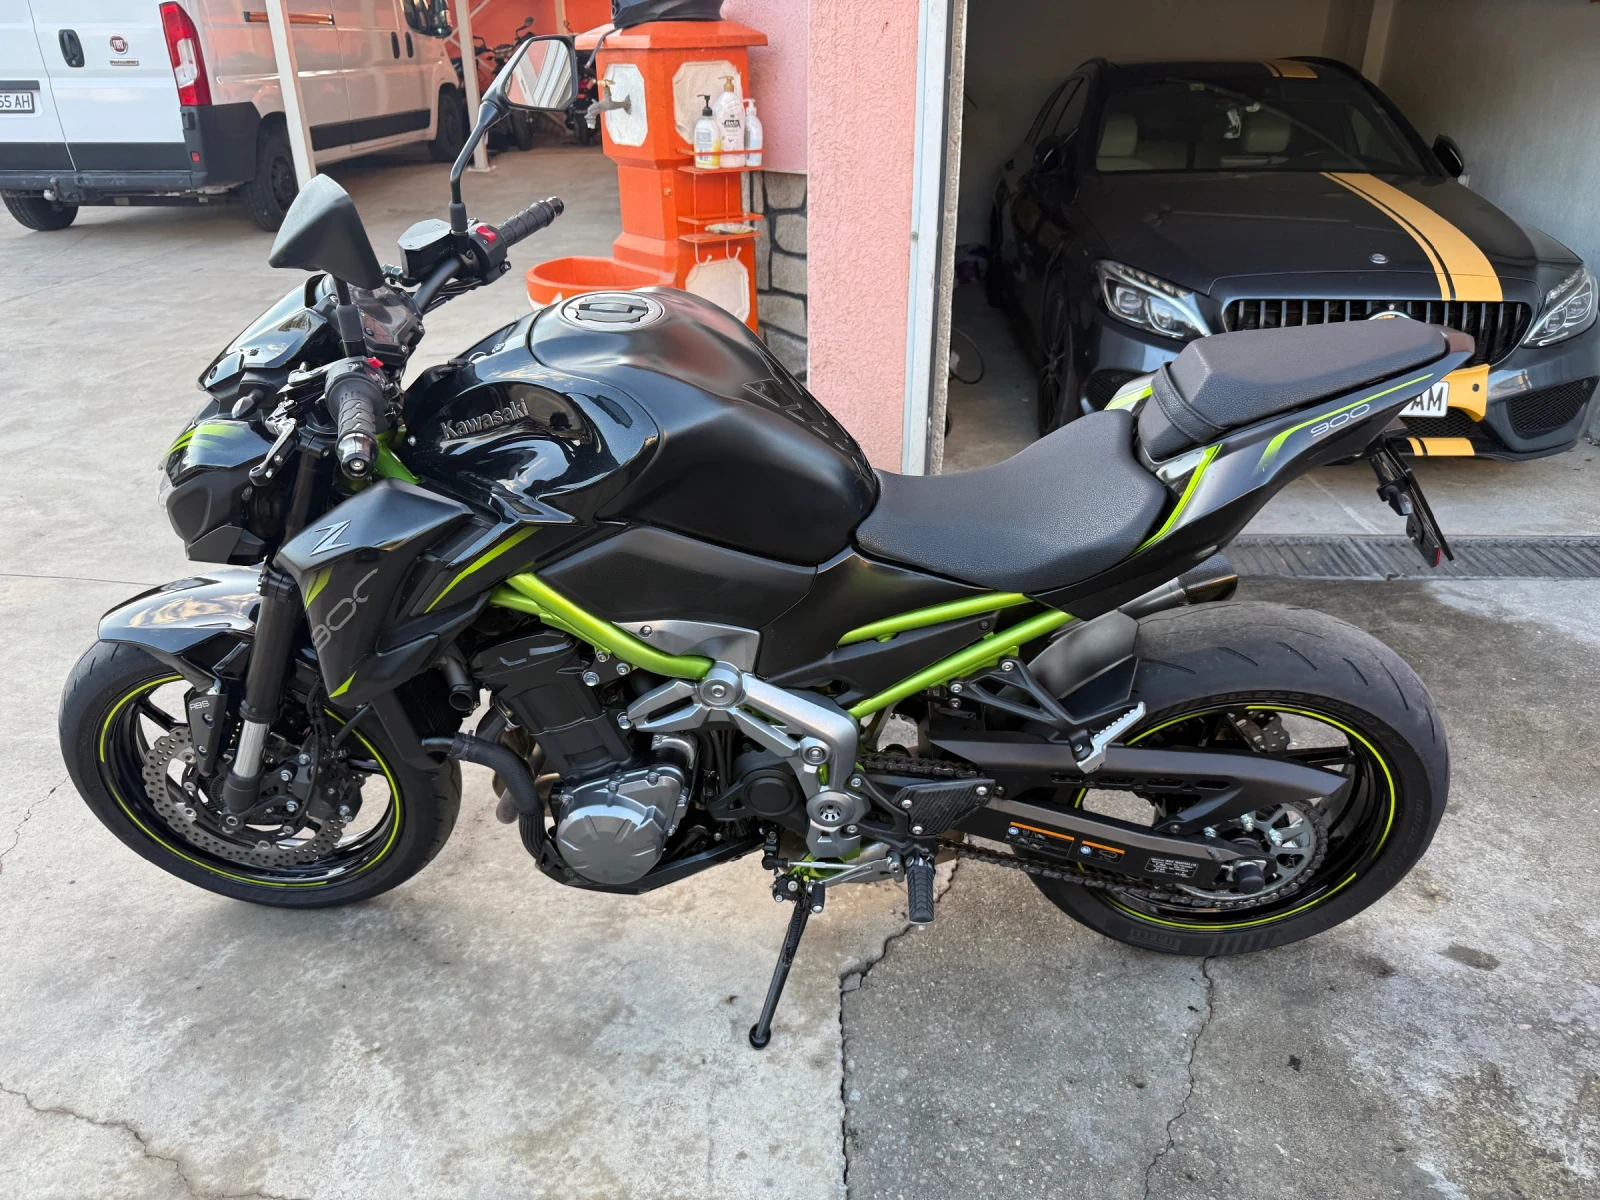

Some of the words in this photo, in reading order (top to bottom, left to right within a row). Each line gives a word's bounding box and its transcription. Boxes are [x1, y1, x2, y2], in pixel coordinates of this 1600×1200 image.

[14, 94, 31, 109] AH
[1410, 386, 1444, 412] AM
[440, 397, 530, 440] Kawasaki
[1309, 402, 1371, 438] 900
[310, 519, 352, 557] Z
[188, 699, 210, 711] ABS
